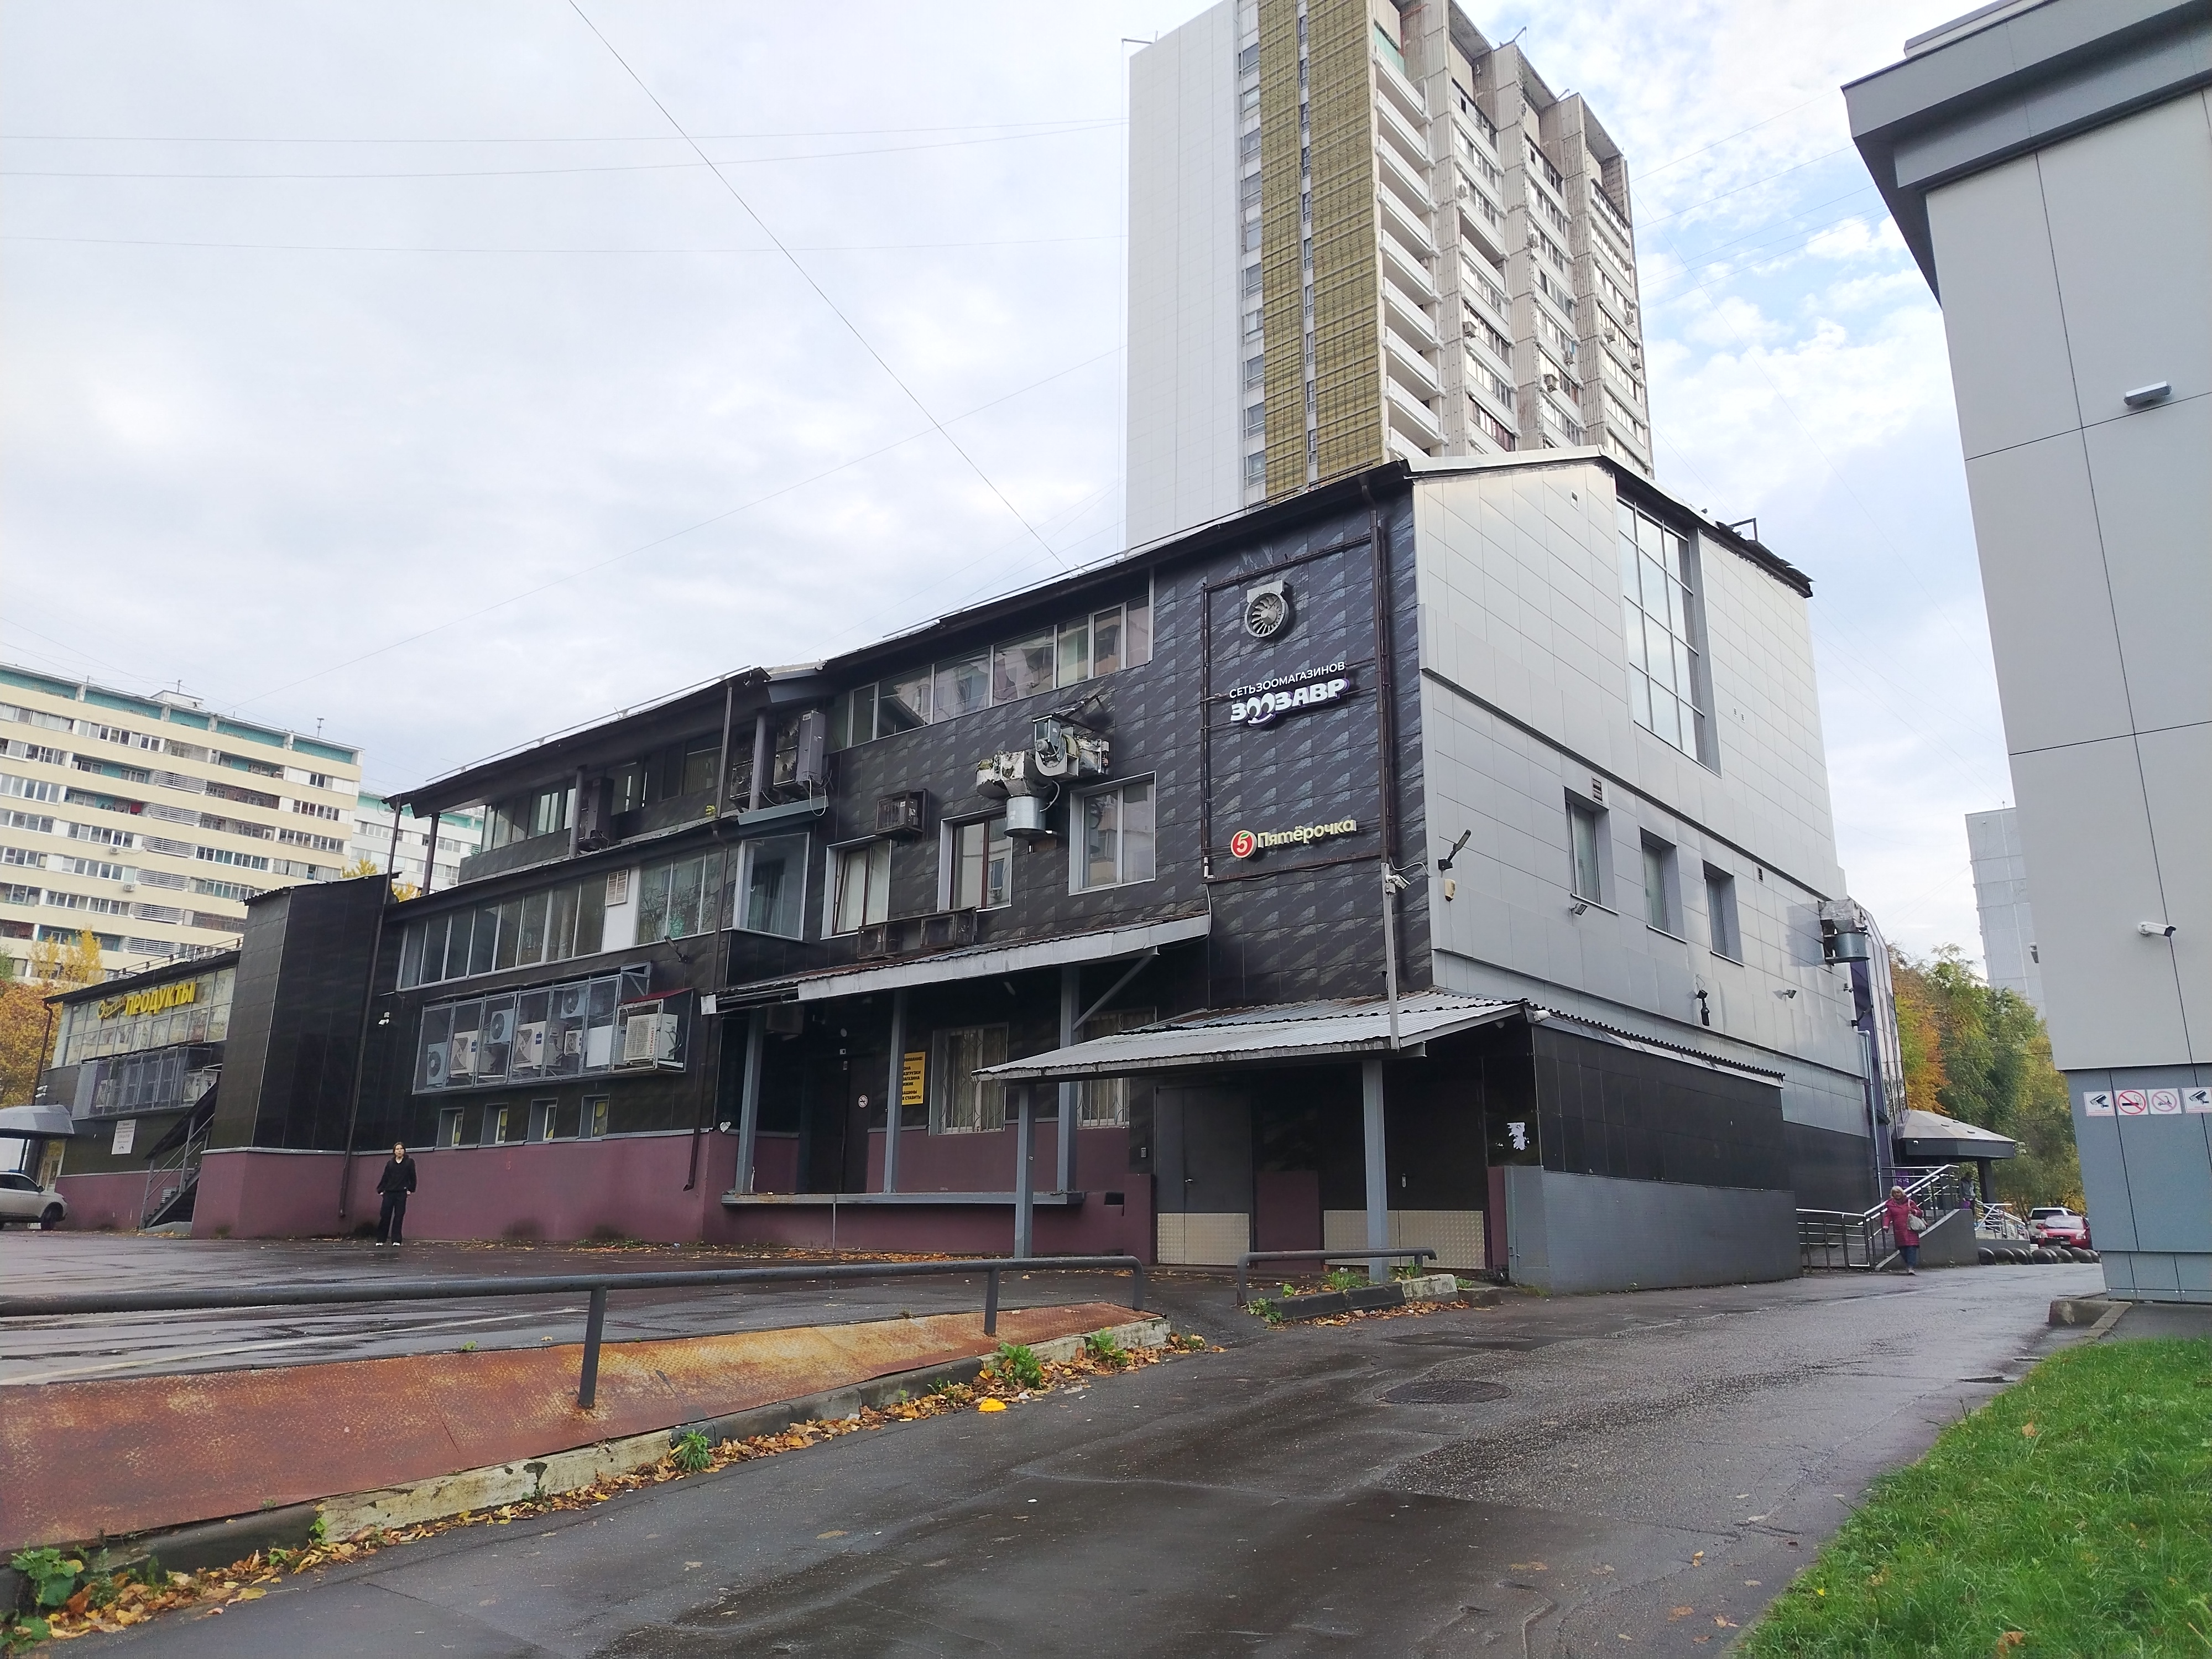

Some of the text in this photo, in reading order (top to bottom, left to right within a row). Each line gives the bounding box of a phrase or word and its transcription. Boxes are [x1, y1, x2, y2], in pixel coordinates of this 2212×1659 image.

[1230, 679, 1348, 724] ЗООЗАВР
[1258, 820, 1357, 848] Пятёрочка
[126, 982, 196, 1015] ПРОДУКТЫ
